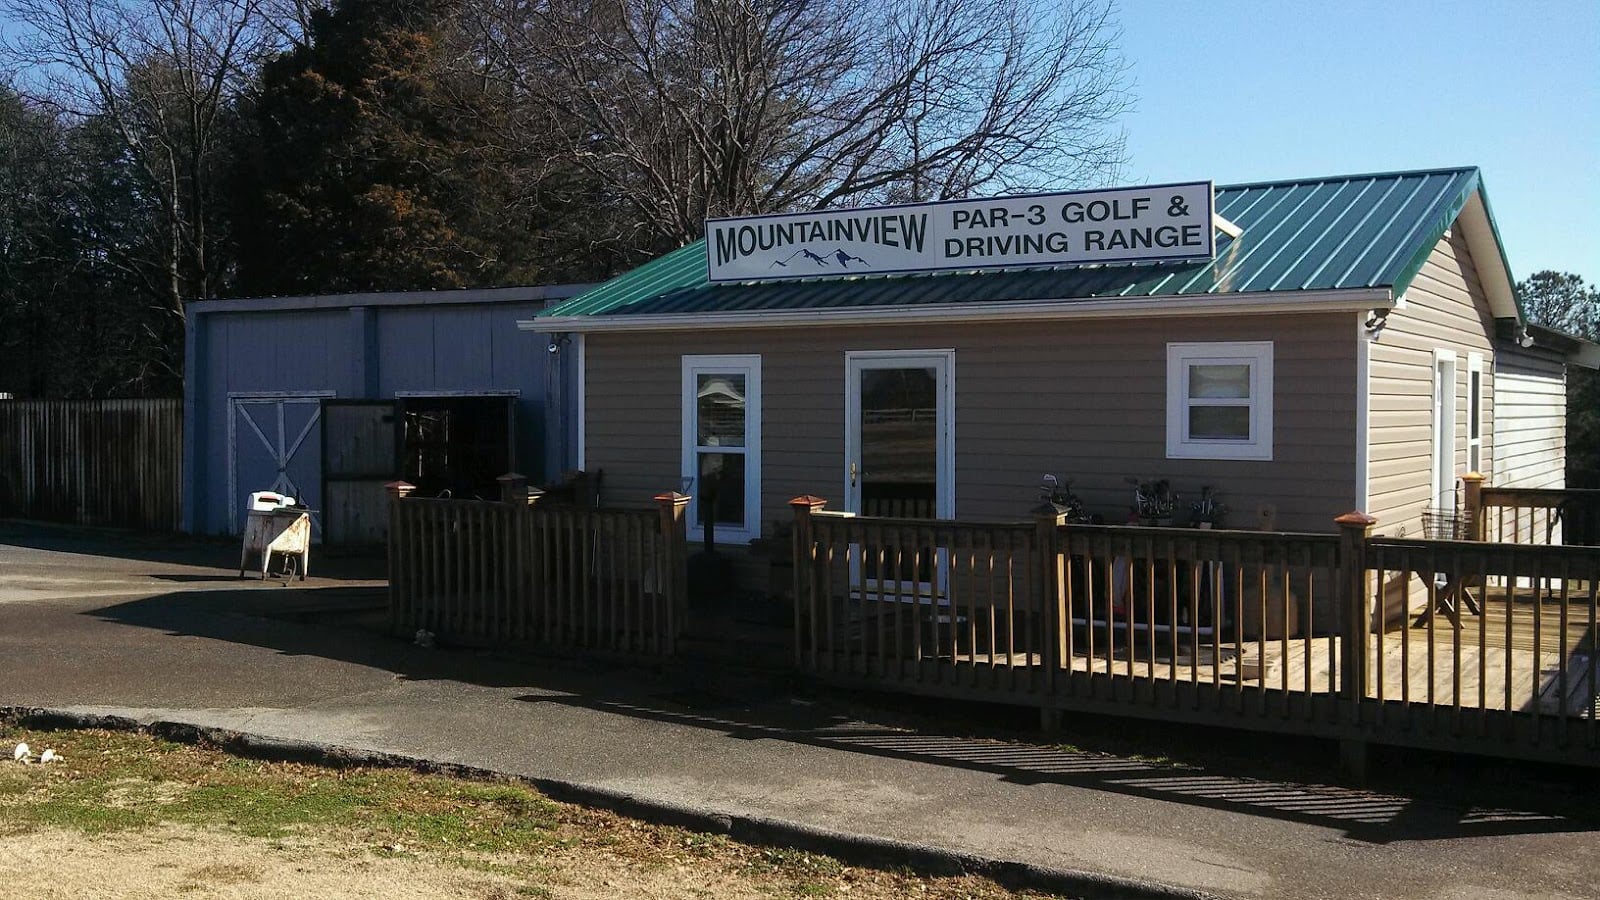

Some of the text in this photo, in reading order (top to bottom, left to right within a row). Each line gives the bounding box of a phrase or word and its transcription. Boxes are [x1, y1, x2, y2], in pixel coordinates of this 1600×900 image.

[952, 195, 1190, 230] PAR-3 GOLF &
[715, 213, 928, 267] MOUNTAINVIEW
[944, 224, 1202, 258] DRIVING RANGE
